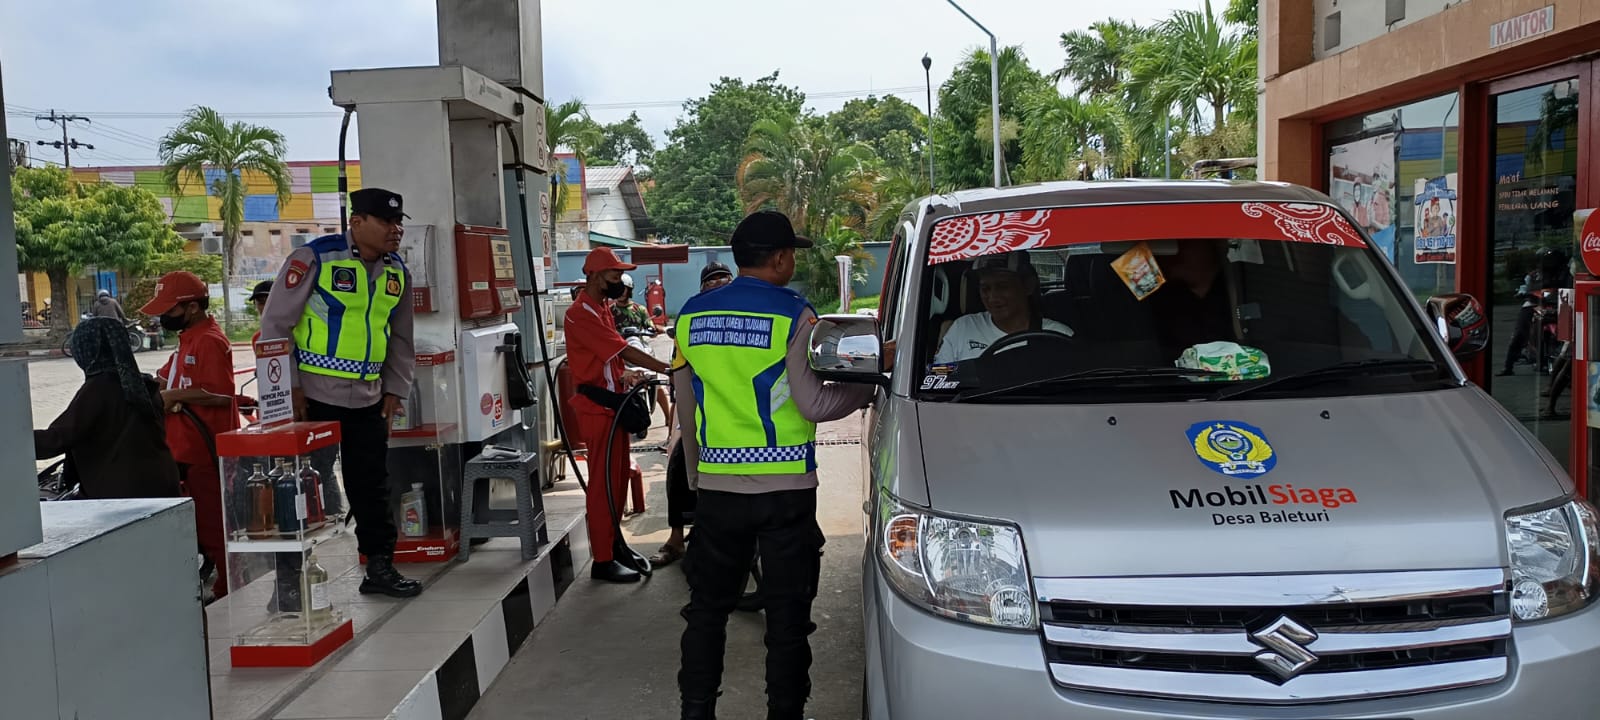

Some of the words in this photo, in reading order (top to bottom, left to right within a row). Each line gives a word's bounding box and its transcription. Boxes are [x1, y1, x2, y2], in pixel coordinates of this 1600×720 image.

[1496, 9, 1548, 45] KANTOR
[1530, 200, 1559, 209] UANG
[747, 334, 769, 347] SABAR
[1169, 484, 1268, 508] Mobil
[1268, 484, 1358, 508] Siaga
[1212, 512, 1255, 526] Desa
[1259, 509, 1330, 523] Baleturi
